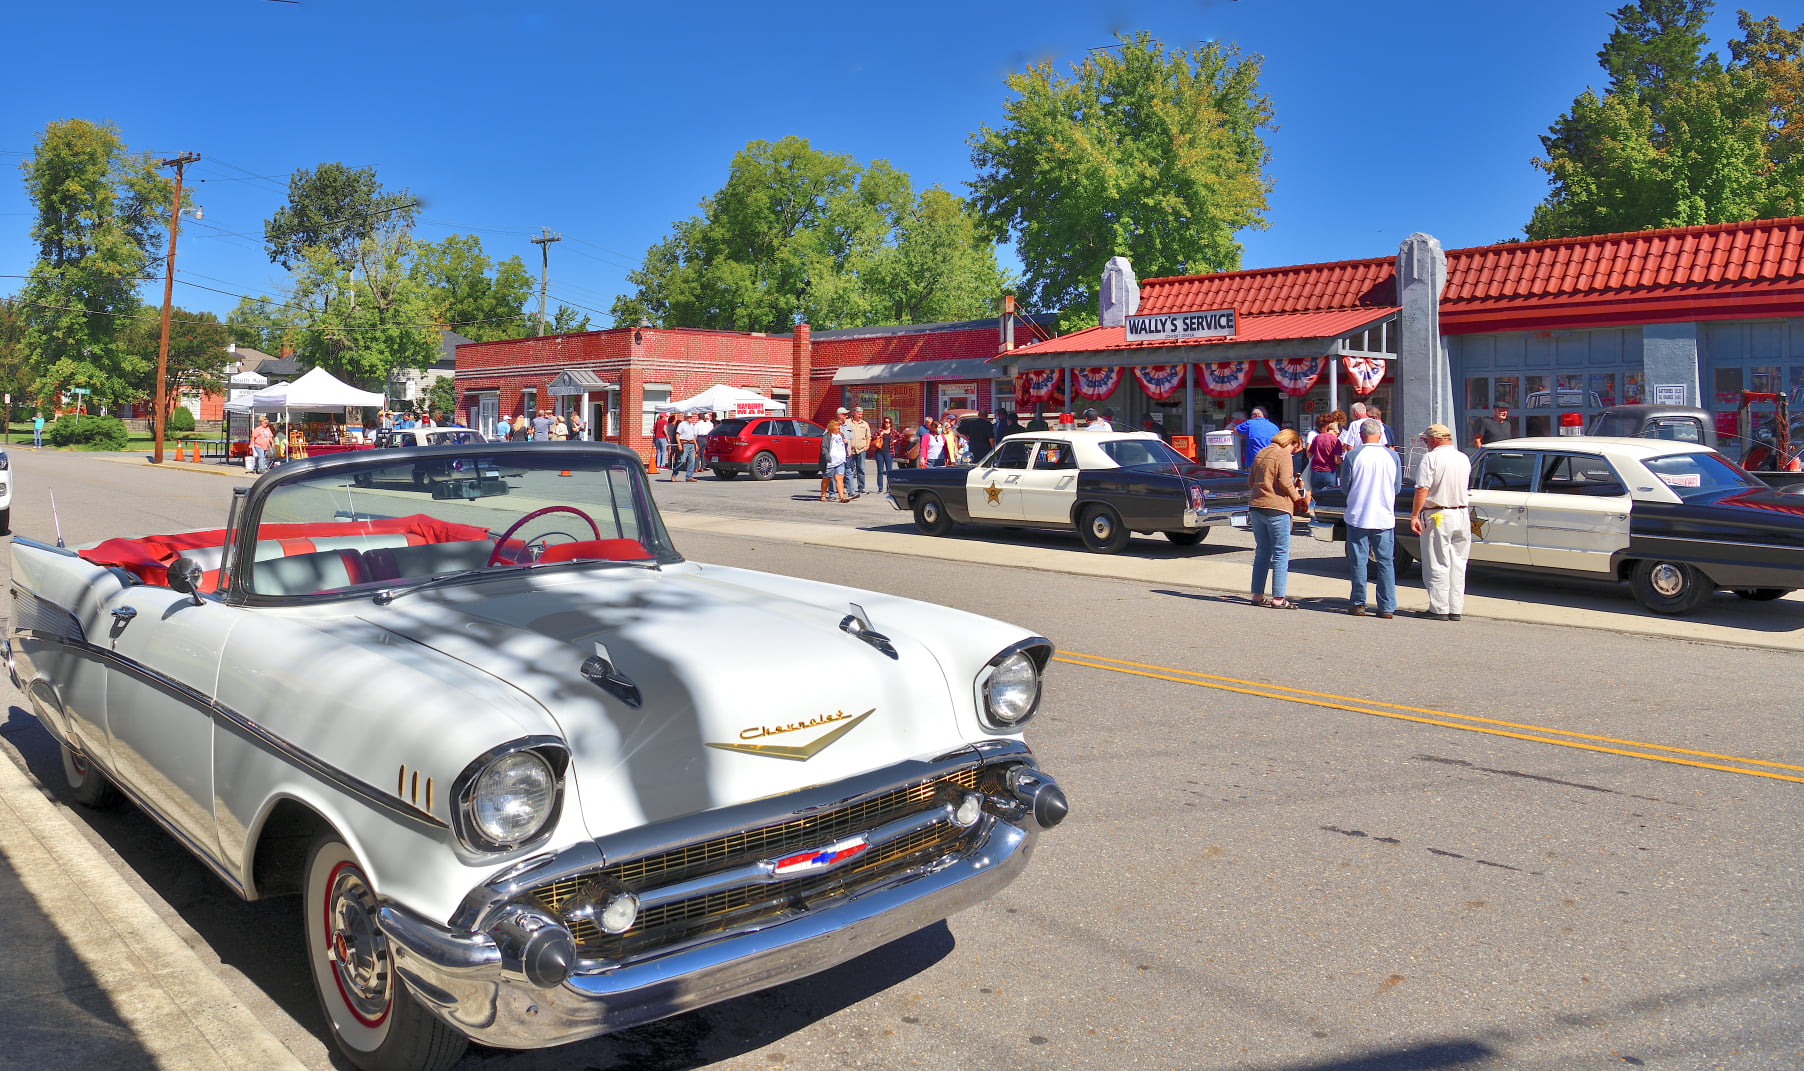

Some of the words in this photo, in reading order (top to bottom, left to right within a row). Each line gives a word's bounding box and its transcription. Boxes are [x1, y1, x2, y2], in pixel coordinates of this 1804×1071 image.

[1128, 315, 1178, 334] WALLY'S
[1182, 313, 1234, 331] SERVICE
[736, 402, 764, 410] MAYBERRY
[740, 709, 853, 740] Chevrolet
